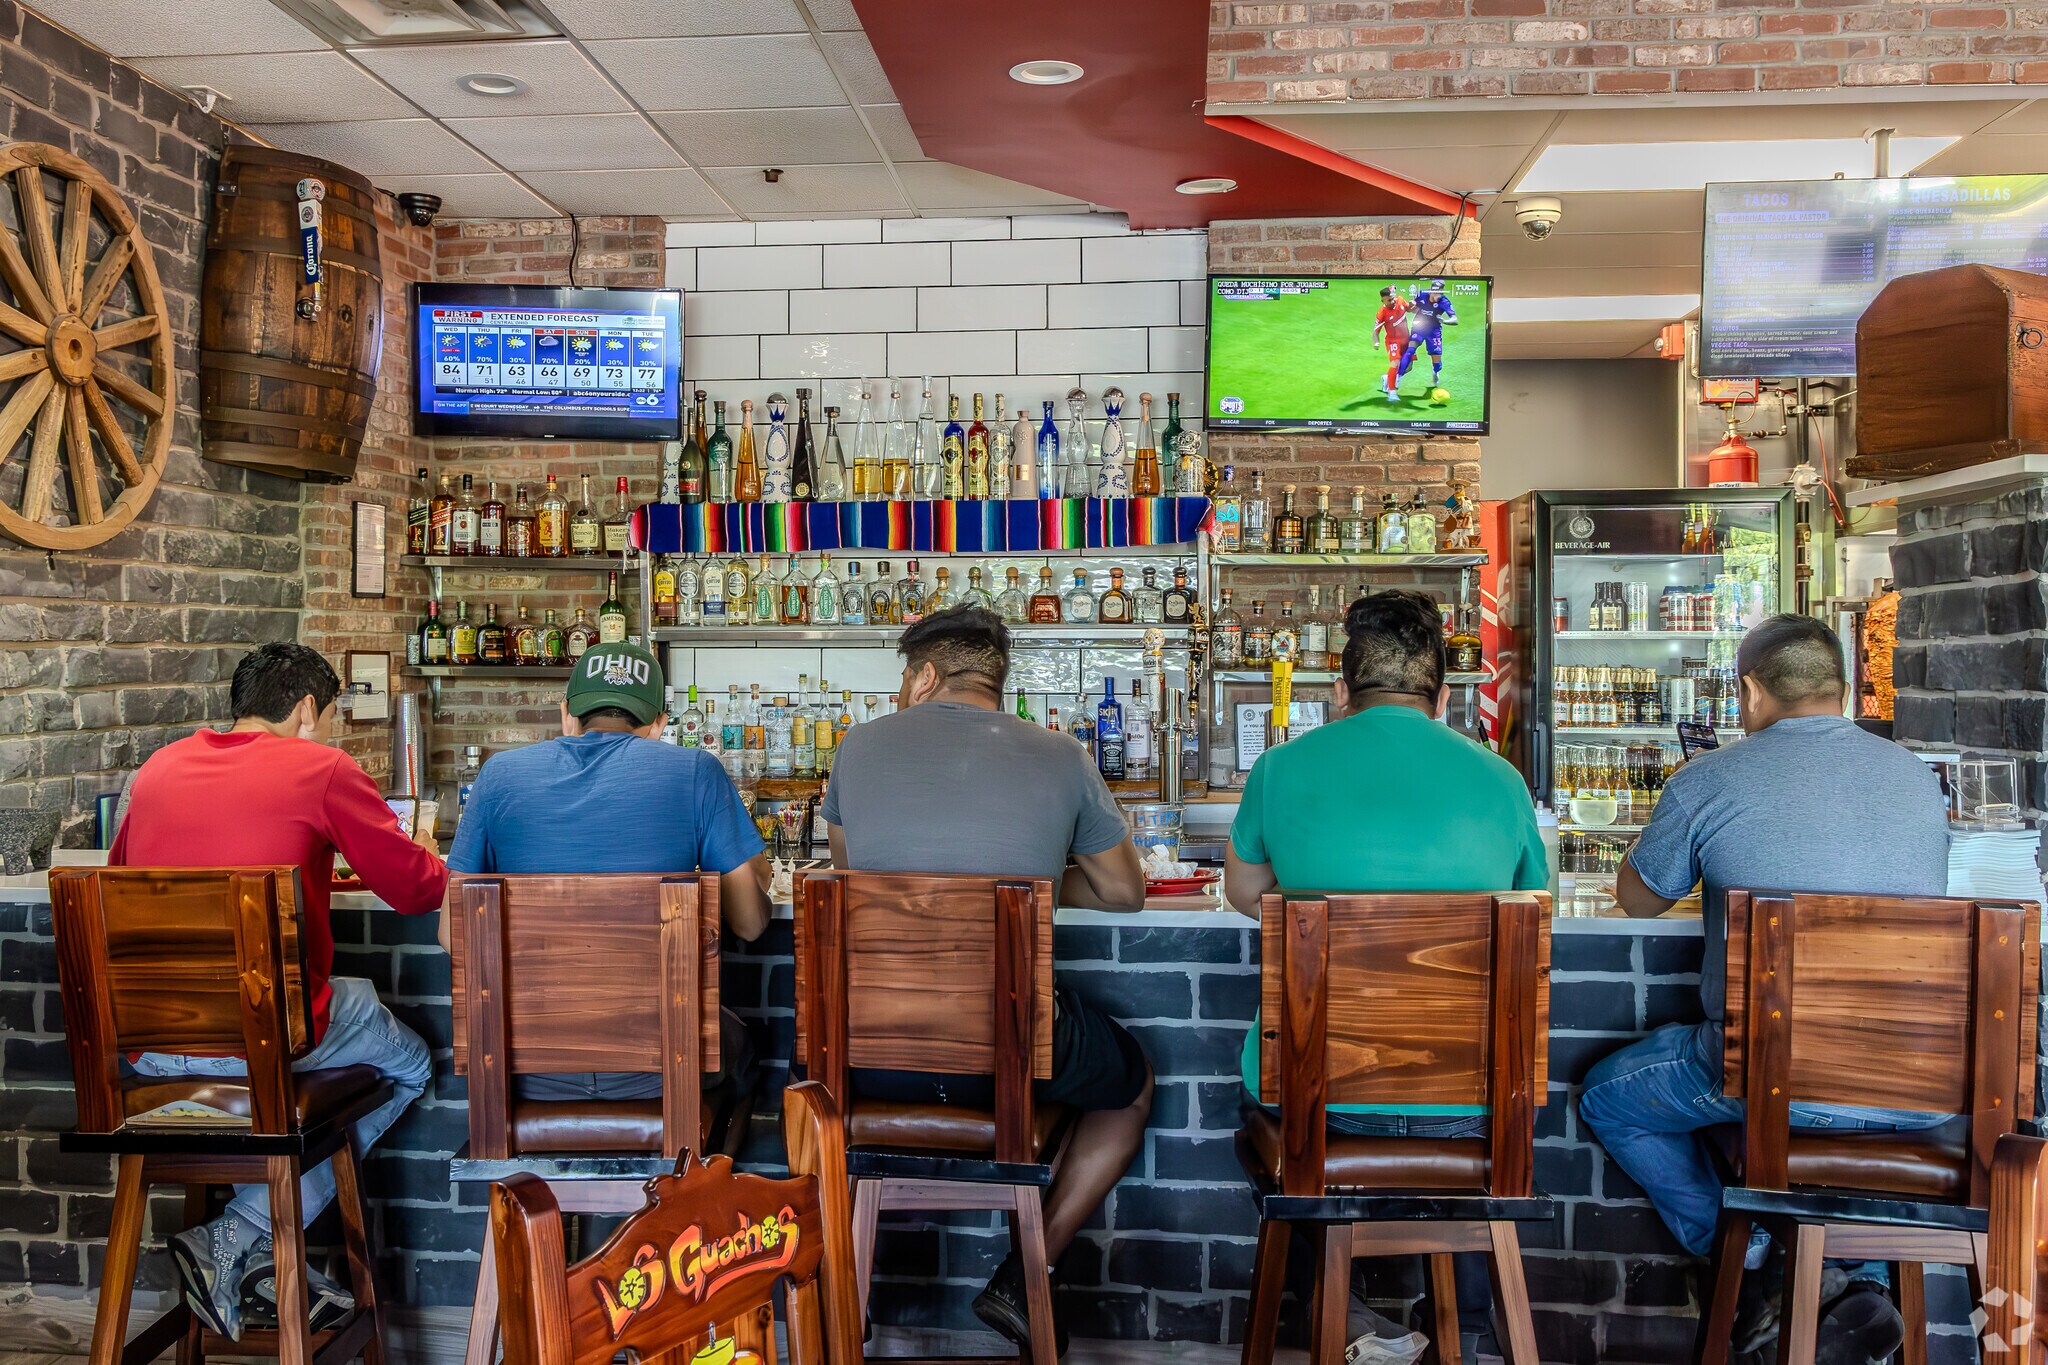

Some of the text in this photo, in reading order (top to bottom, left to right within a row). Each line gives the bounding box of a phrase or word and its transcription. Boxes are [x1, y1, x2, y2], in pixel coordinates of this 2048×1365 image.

[1744, 193, 1790, 206] TACOS
[1911, 188, 2011, 203] QUESADILLAS
[306, 234, 317, 276] Corona
[491, 313, 600, 322] EXTENDED FORECAST
[443, 365, 656, 379] 84 71 63 66 69 73 77
[646, 394, 659, 406] 6
[586, 654, 650, 684] OHIO
[669, 1204, 800, 1304] Guachos
